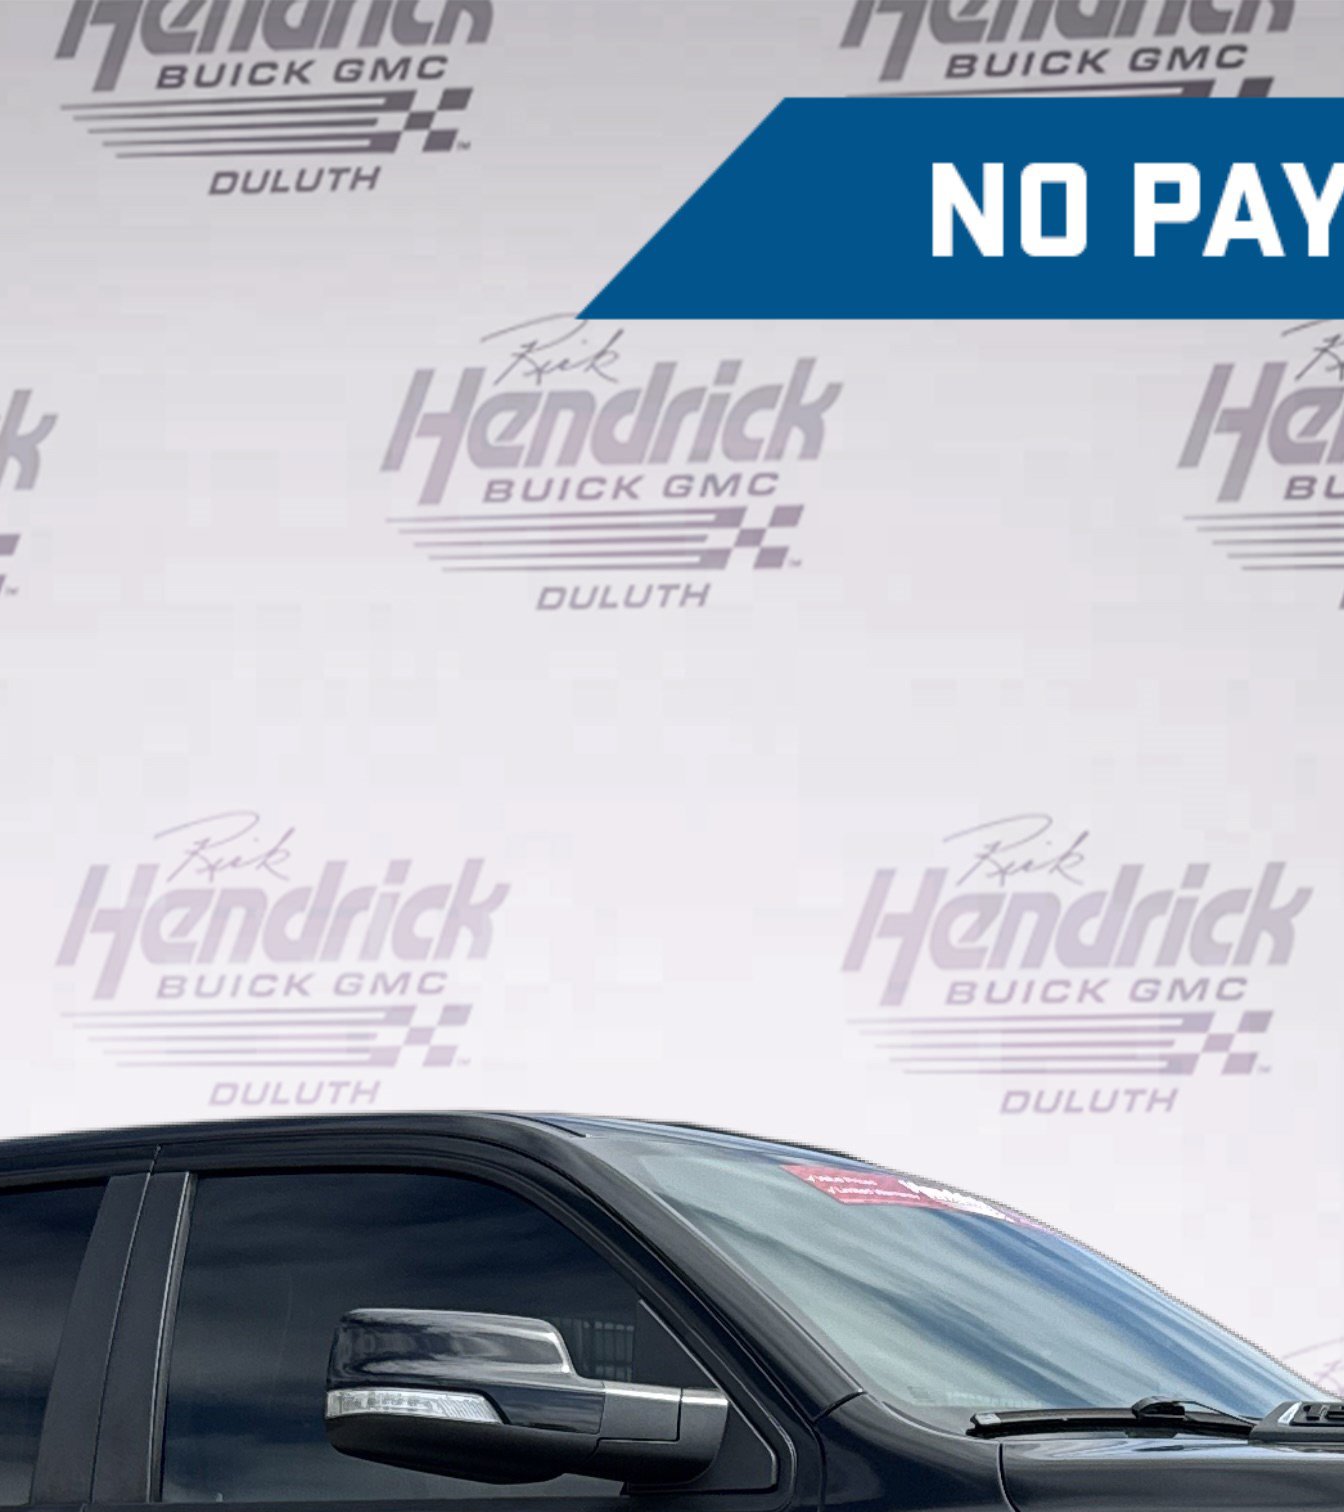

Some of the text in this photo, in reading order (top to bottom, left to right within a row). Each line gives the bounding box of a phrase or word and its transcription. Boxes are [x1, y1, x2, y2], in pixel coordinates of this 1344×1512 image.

[156, 55, 448, 90] BUICK GMC
[945, 44, 1248, 79] BUICK GMC
[208, 166, 381, 195] DULUTH
[380, 357, 843, 505] Hendrick
[482, 472, 779, 503] BUICK GMC
[536, 583, 711, 610] DULUTH
[55, 858, 511, 1000] Hendrick
[841, 861, 1313, 1007] Hendrick
[156, 970, 448, 1000] BUICK GMC
[945, 976, 1248, 1005] BUICK GMC
[208, 1080, 381, 1106] DULUTH
[1000, 1088, 1179, 1114] DULUTH
